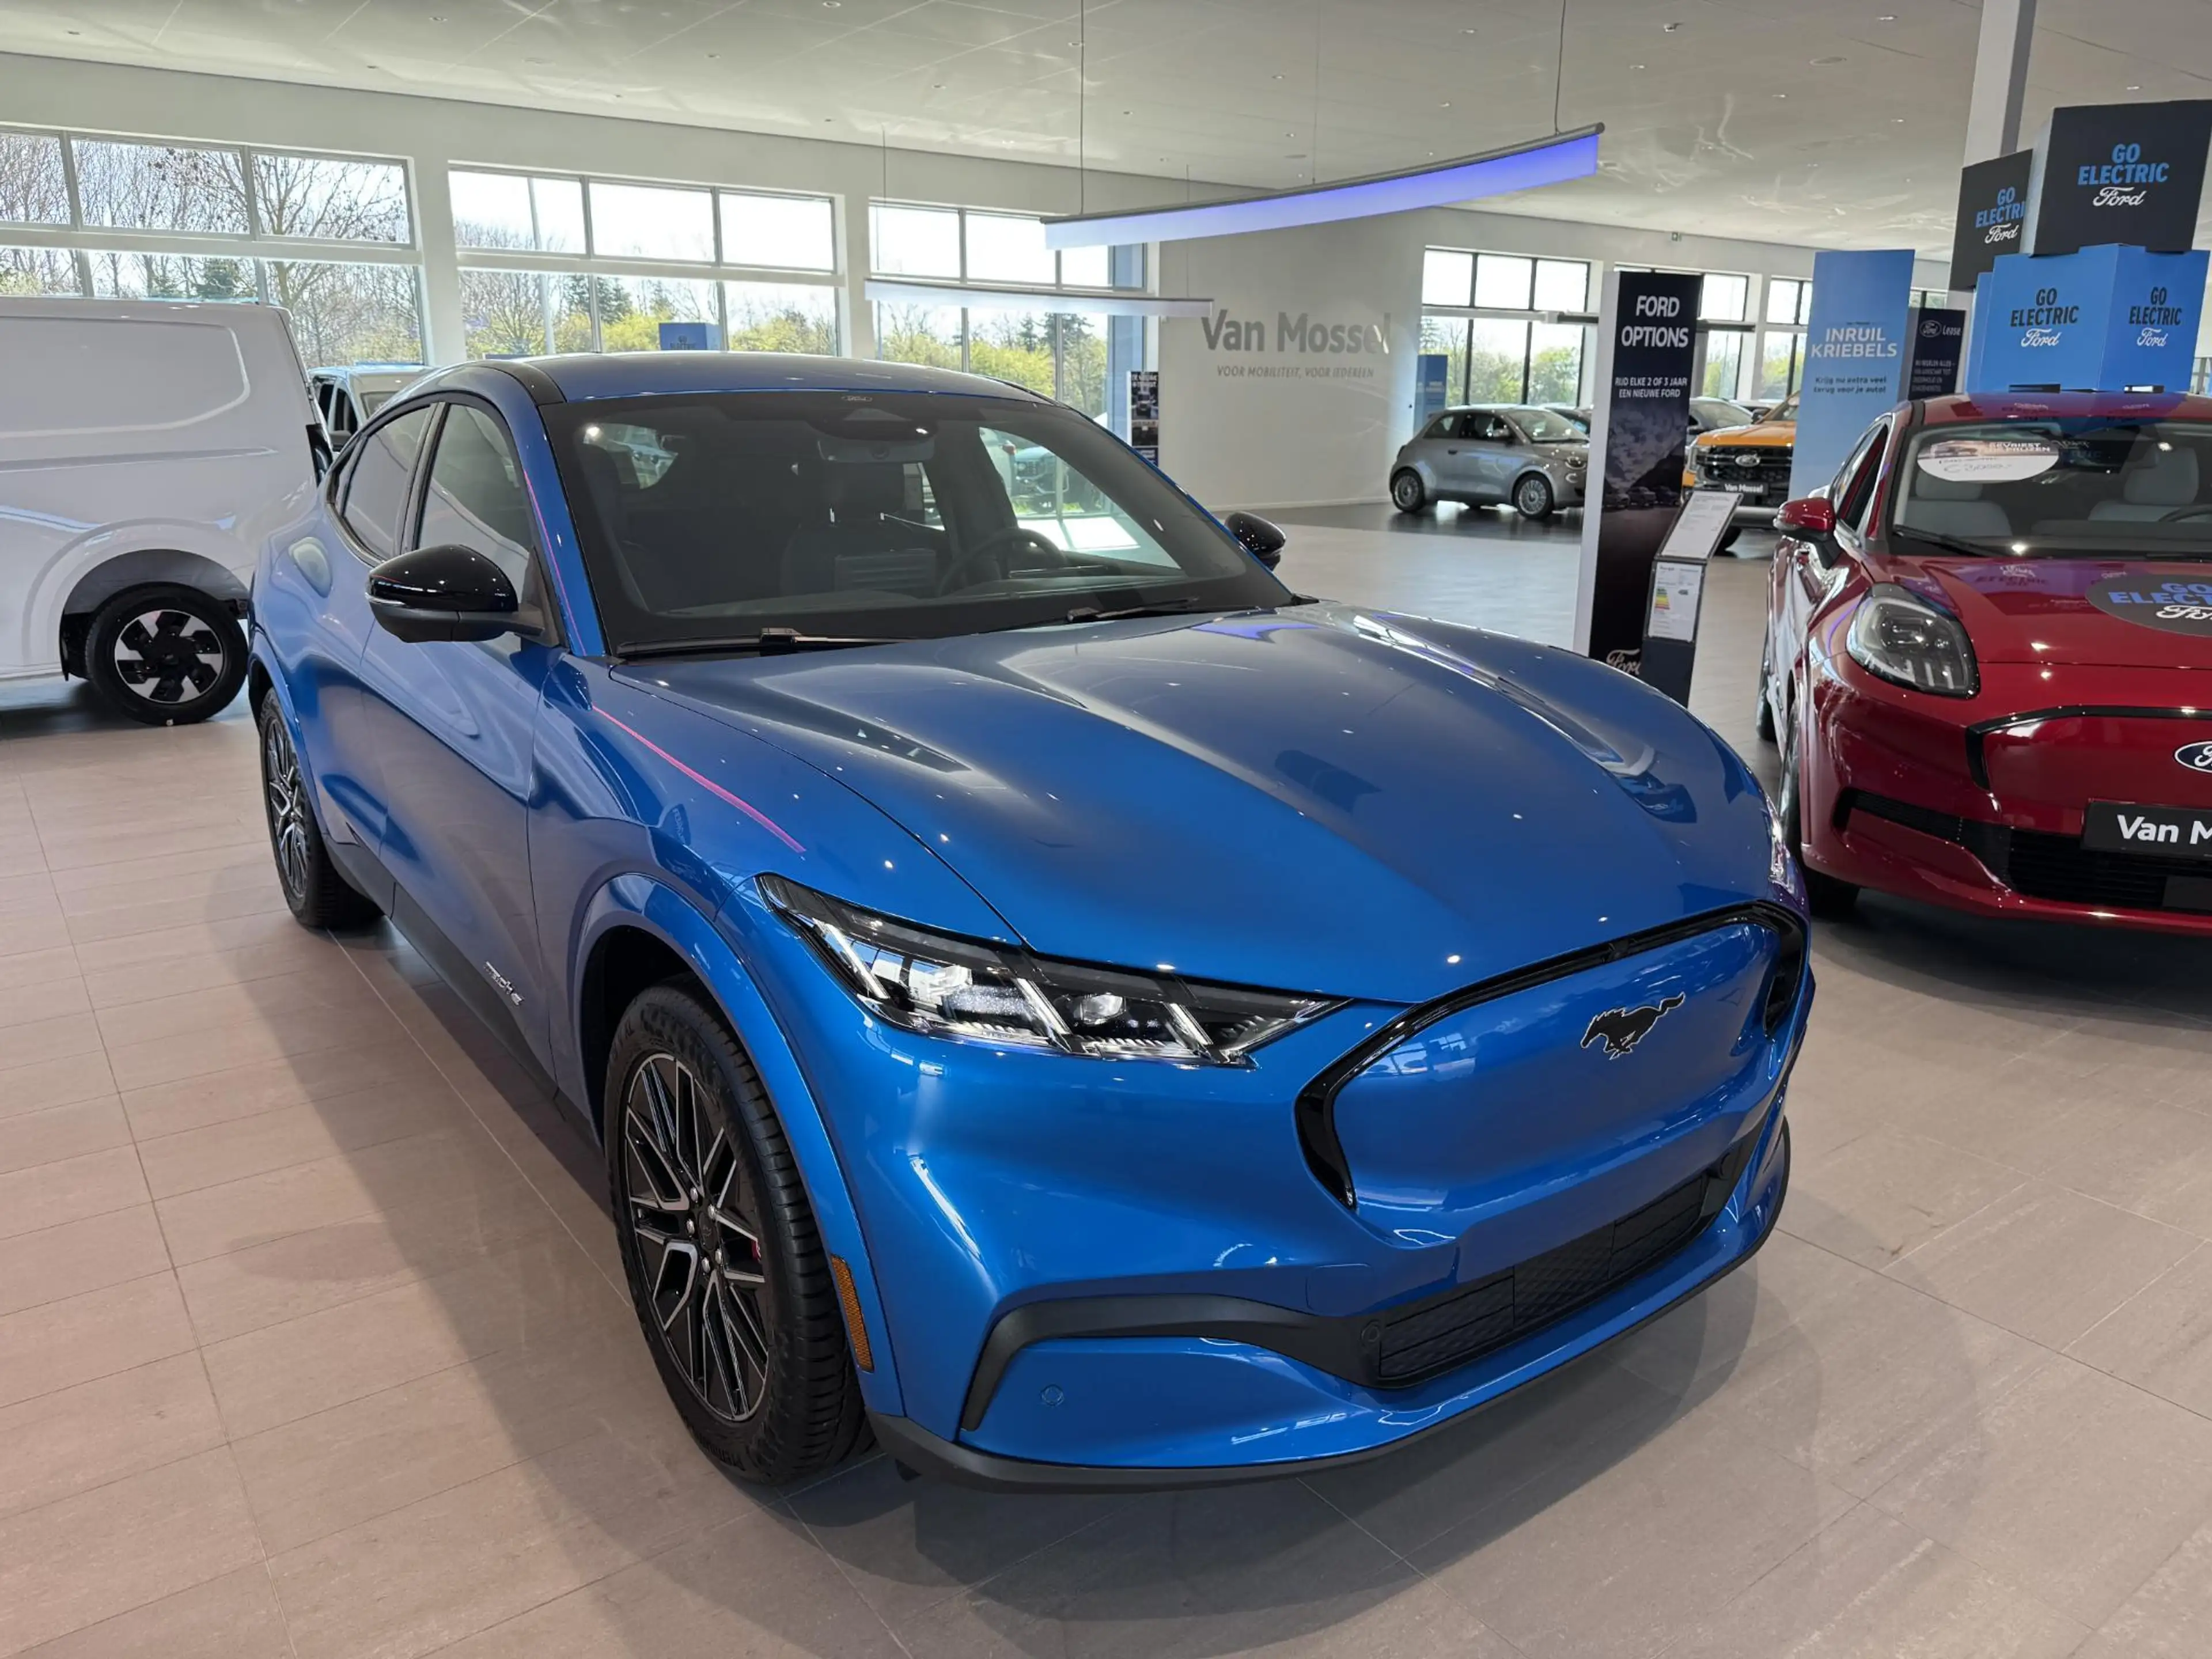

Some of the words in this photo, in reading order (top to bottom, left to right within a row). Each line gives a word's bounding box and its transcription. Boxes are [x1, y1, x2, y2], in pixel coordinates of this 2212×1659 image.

[2111, 143, 2141, 164] GO
[2077, 162, 2169, 185] ELECTRIC
[1997, 186, 2016, 206] GO
[2092, 186, 2147, 206] Ford
[1984, 222, 2020, 244] Ford
[2035, 287, 2058, 306] GO
[2150, 286, 2167, 305] GO
[1635, 295, 1680, 317] FORD
[2010, 305, 2079, 327] ELECTRIC
[2128, 306, 2183, 326] ELECTRIC
[1201, 309, 1265, 352] Van
[1277, 312, 1391, 353] Mossel
[1621, 325, 1689, 348] OPTIONS
[1825, 327, 1886, 342] INRUIL
[1942, 325, 1962, 336] Lease
[2020, 328, 2062, 347] Ford
[2137, 327, 2169, 347] Ford
[1810, 343, 1897, 358] KRIEBELS
[1217, 365, 1245, 377] VOOR
[1304, 366, 1331, 378] VOOR
[1815, 376, 1833, 385] Krijg
[1870, 376, 1887, 384] veel
[1615, 377, 1628, 387] RIJD
[1630, 377, 1646, 387] ELKE
[1647, 377, 1652, 386] 2
[1653, 377, 1662, 387] OF
[1664, 377, 1668, 386] 3
[1669, 377, 1688, 387] JAAR
[1813, 386, 1835, 395] terug
[1619, 389, 1631, 398] EEN
[1633, 389, 1660, 398] NIEUWE
[1661, 389, 1681, 398] FORD
[1725, 483, 1738, 491] Van
[2161, 583, 2212, 594] GO
[2156, 605, 2212, 620] Fo
[2117, 814, 2180, 843] Van
